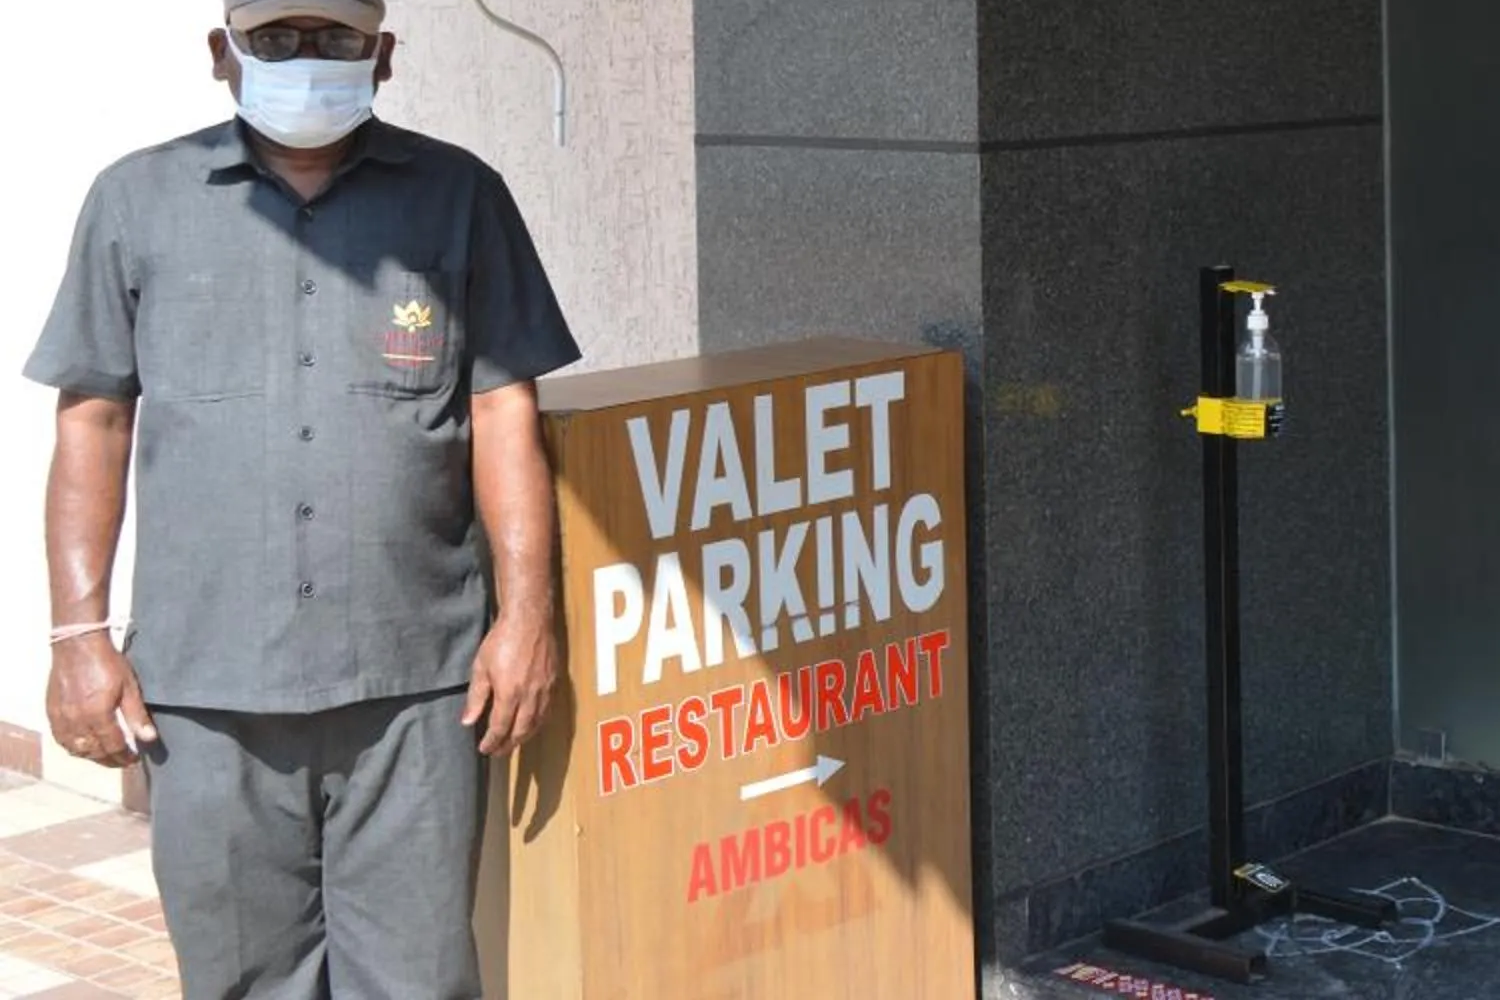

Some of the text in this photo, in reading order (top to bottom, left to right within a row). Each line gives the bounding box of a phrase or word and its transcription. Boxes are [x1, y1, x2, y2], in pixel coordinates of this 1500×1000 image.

[626, 371, 905, 540] VALET
[593, 493, 945, 695] PARKING
[597, 629, 950, 797] RESTAURANT
[686, 788, 892, 904] AMBICAS
